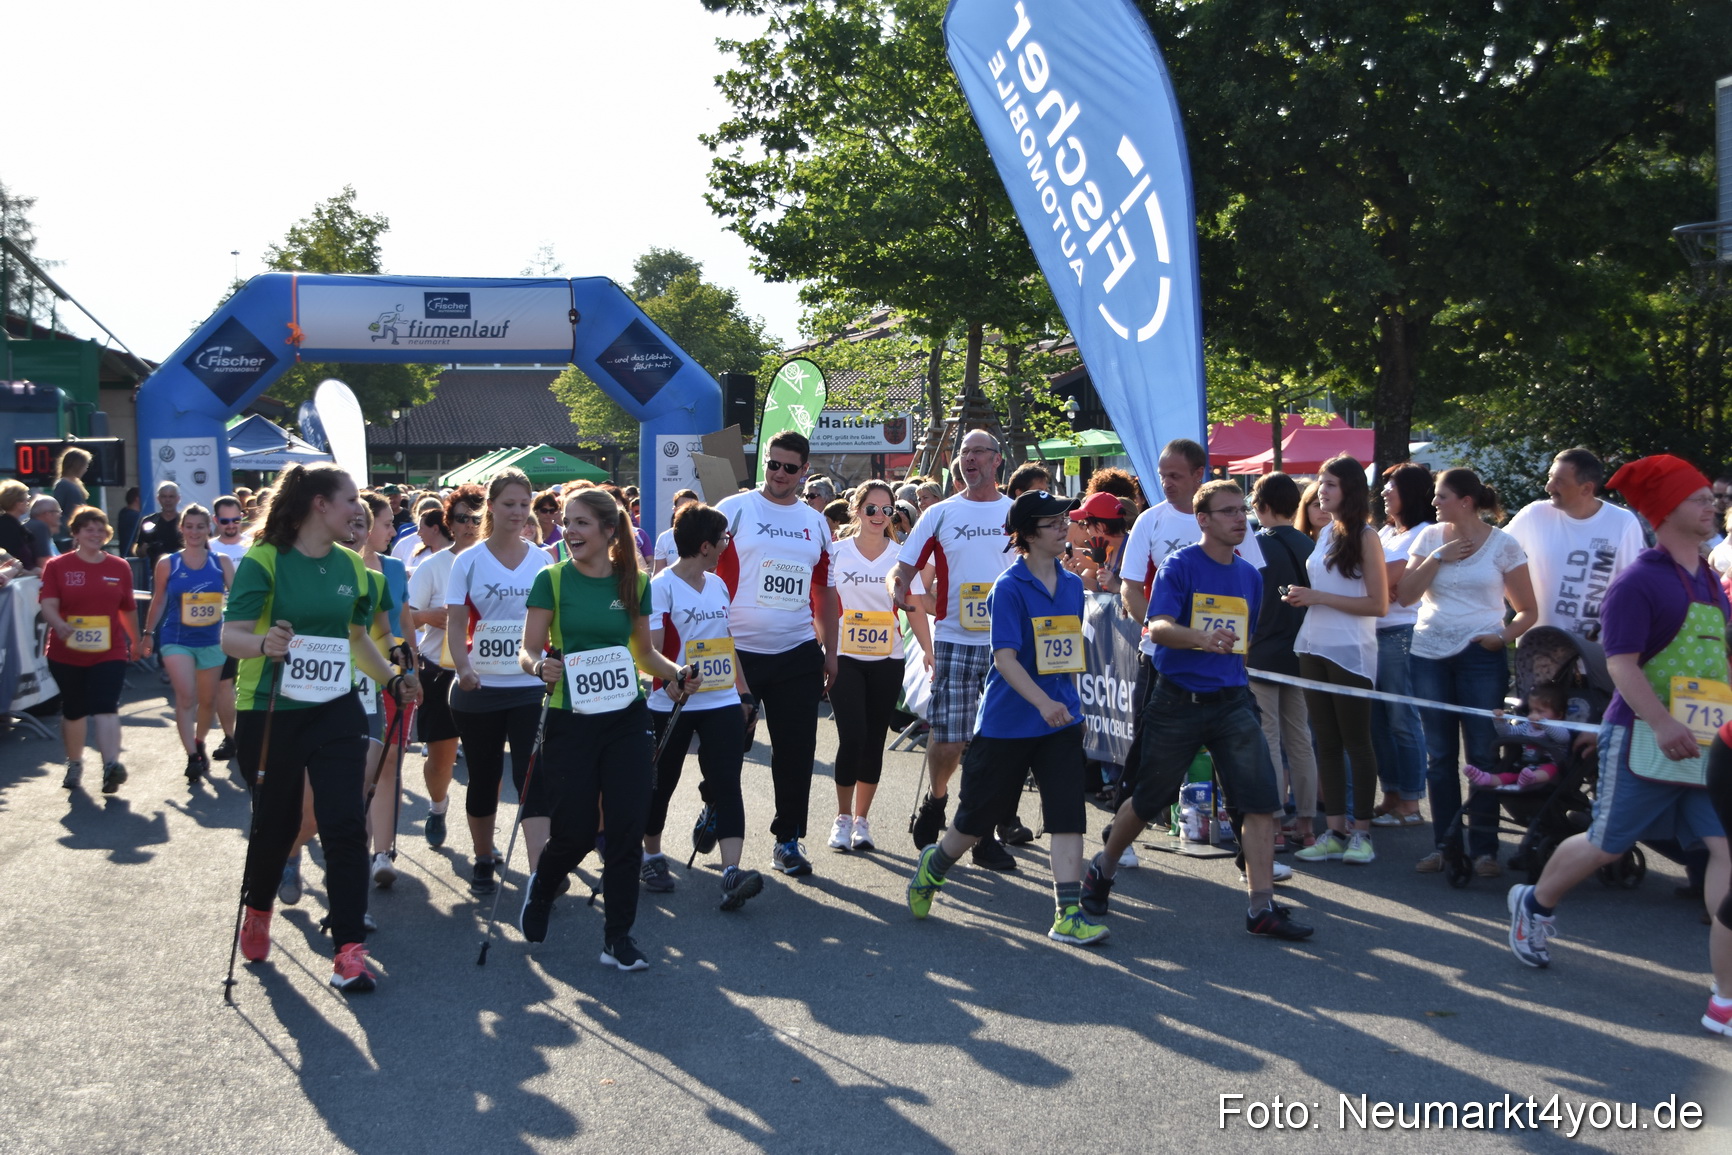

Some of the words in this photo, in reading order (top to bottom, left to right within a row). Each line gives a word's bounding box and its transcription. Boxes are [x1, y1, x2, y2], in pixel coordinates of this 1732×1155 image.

[434, 301, 468, 310] Fischer
[409, 320, 510, 338] firmenlauf
[207, 354, 266, 367] Fischer
[757, 522, 812, 541] Xplus1
[762, 560, 804, 572] df-sports
[65, 571, 86, 586] 13
[763, 575, 803, 595] 8901
[842, 571, 886, 586] Xplus
[1554, 549, 1590, 619] BFLD
[484, 583, 532, 600] Xplus
[1577, 548, 1617, 635] DENIM
[190, 606, 215, 617] 839
[965, 601, 987, 617] 15
[475, 622, 523, 633] df-sports
[75, 630, 103, 642] 852
[847, 628, 888, 643] 1504
[289, 639, 343, 652] df-sports
[1043, 638, 1073, 658] 793
[568, 651, 622, 667] df-sports
[290, 657, 346, 682] 8907
[284, 682, 349, 692] www.df-sports.de
[575, 667, 629, 696] 8905
[574, 690, 636, 705] www.df-sports.de
[1685, 703, 1724, 729] 713
